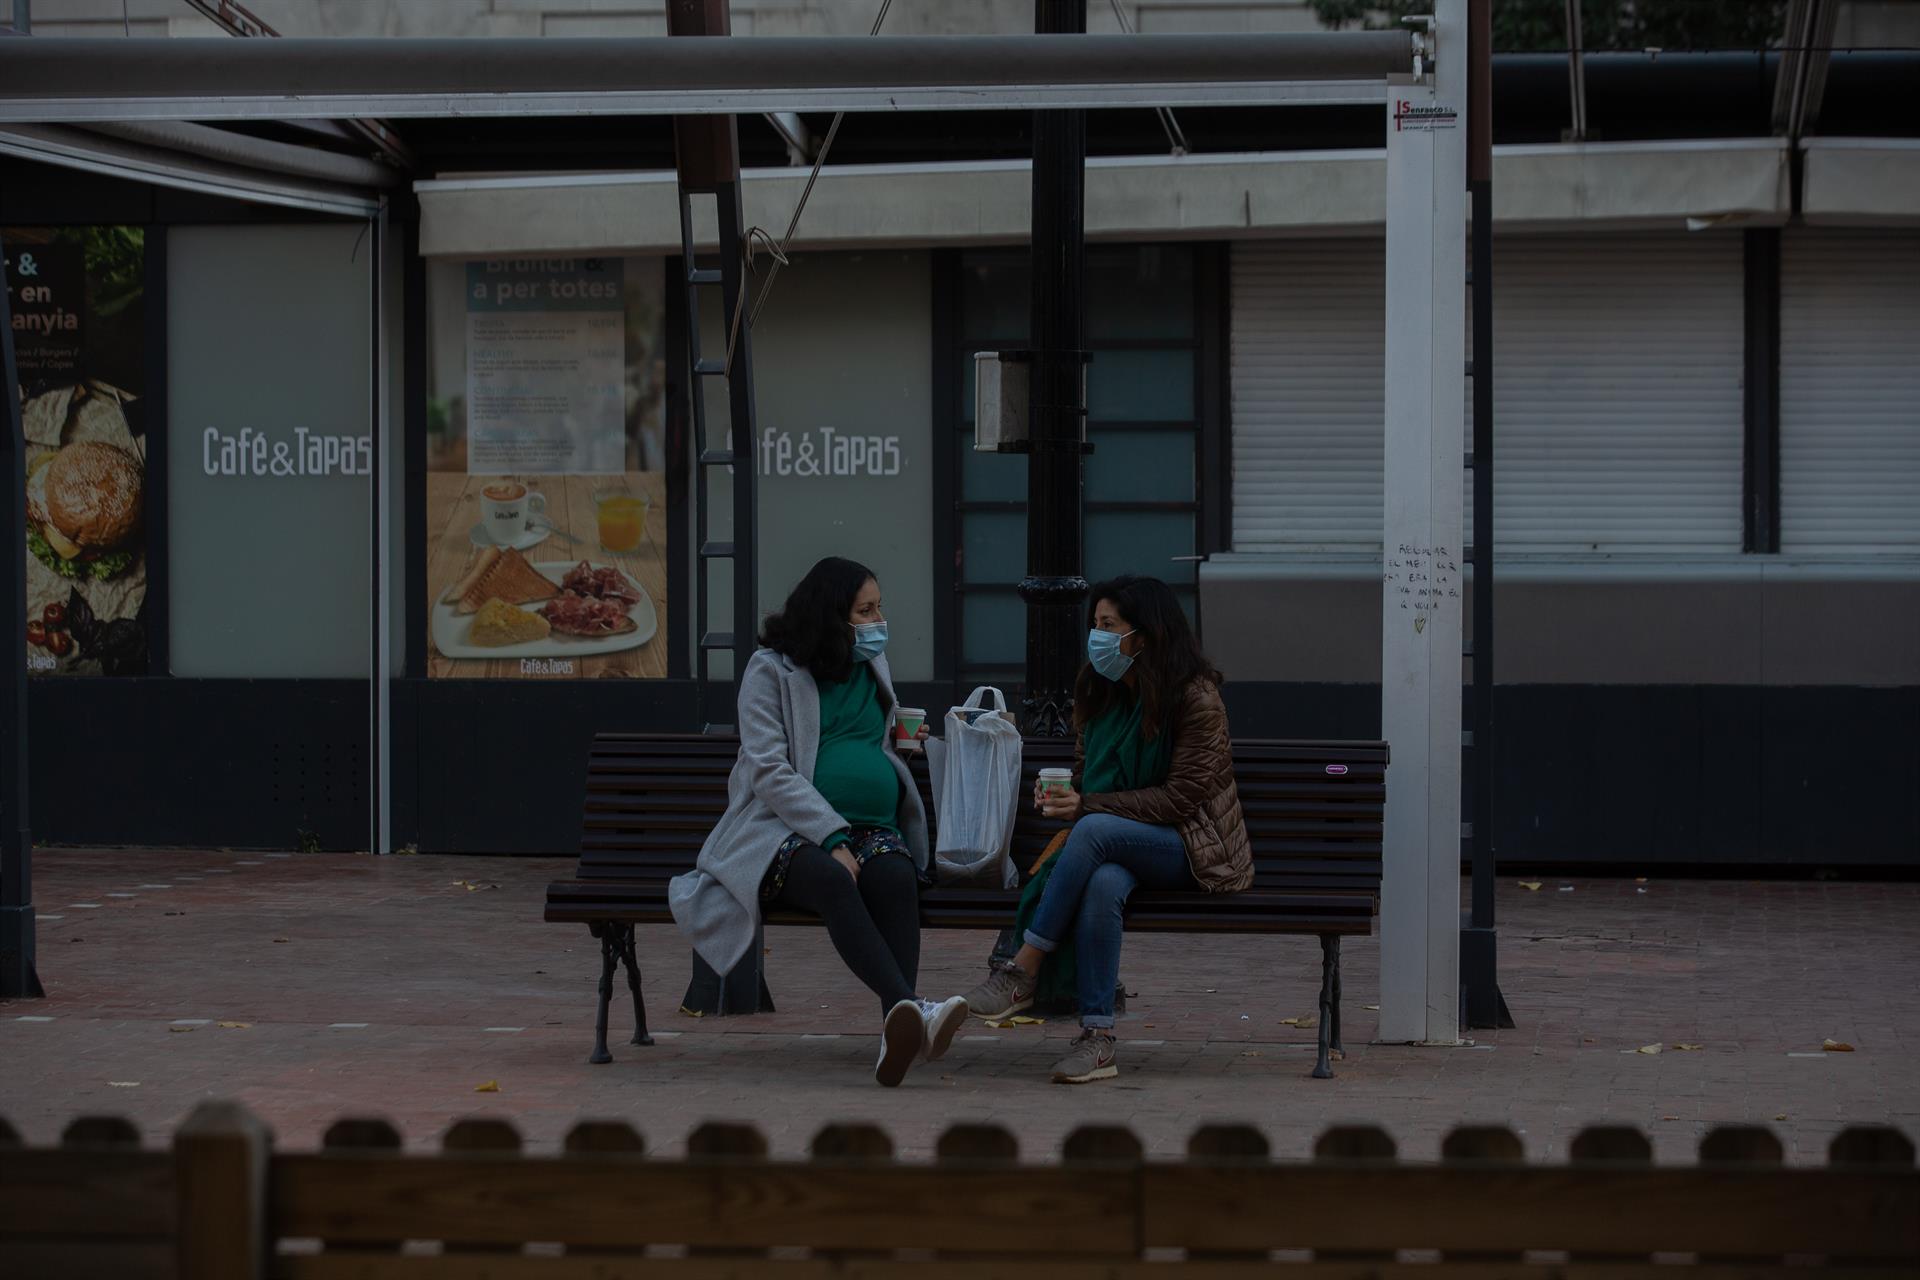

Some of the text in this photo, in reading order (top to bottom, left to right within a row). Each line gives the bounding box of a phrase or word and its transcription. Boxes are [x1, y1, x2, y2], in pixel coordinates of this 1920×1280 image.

[18, 252, 38, 276] &
[21, 286, 52, 304] en
[473, 278, 617, 305] a per totes
[203, 426, 371, 476] Café&Tapas
[727, 426, 900, 476] fé&Tapas
